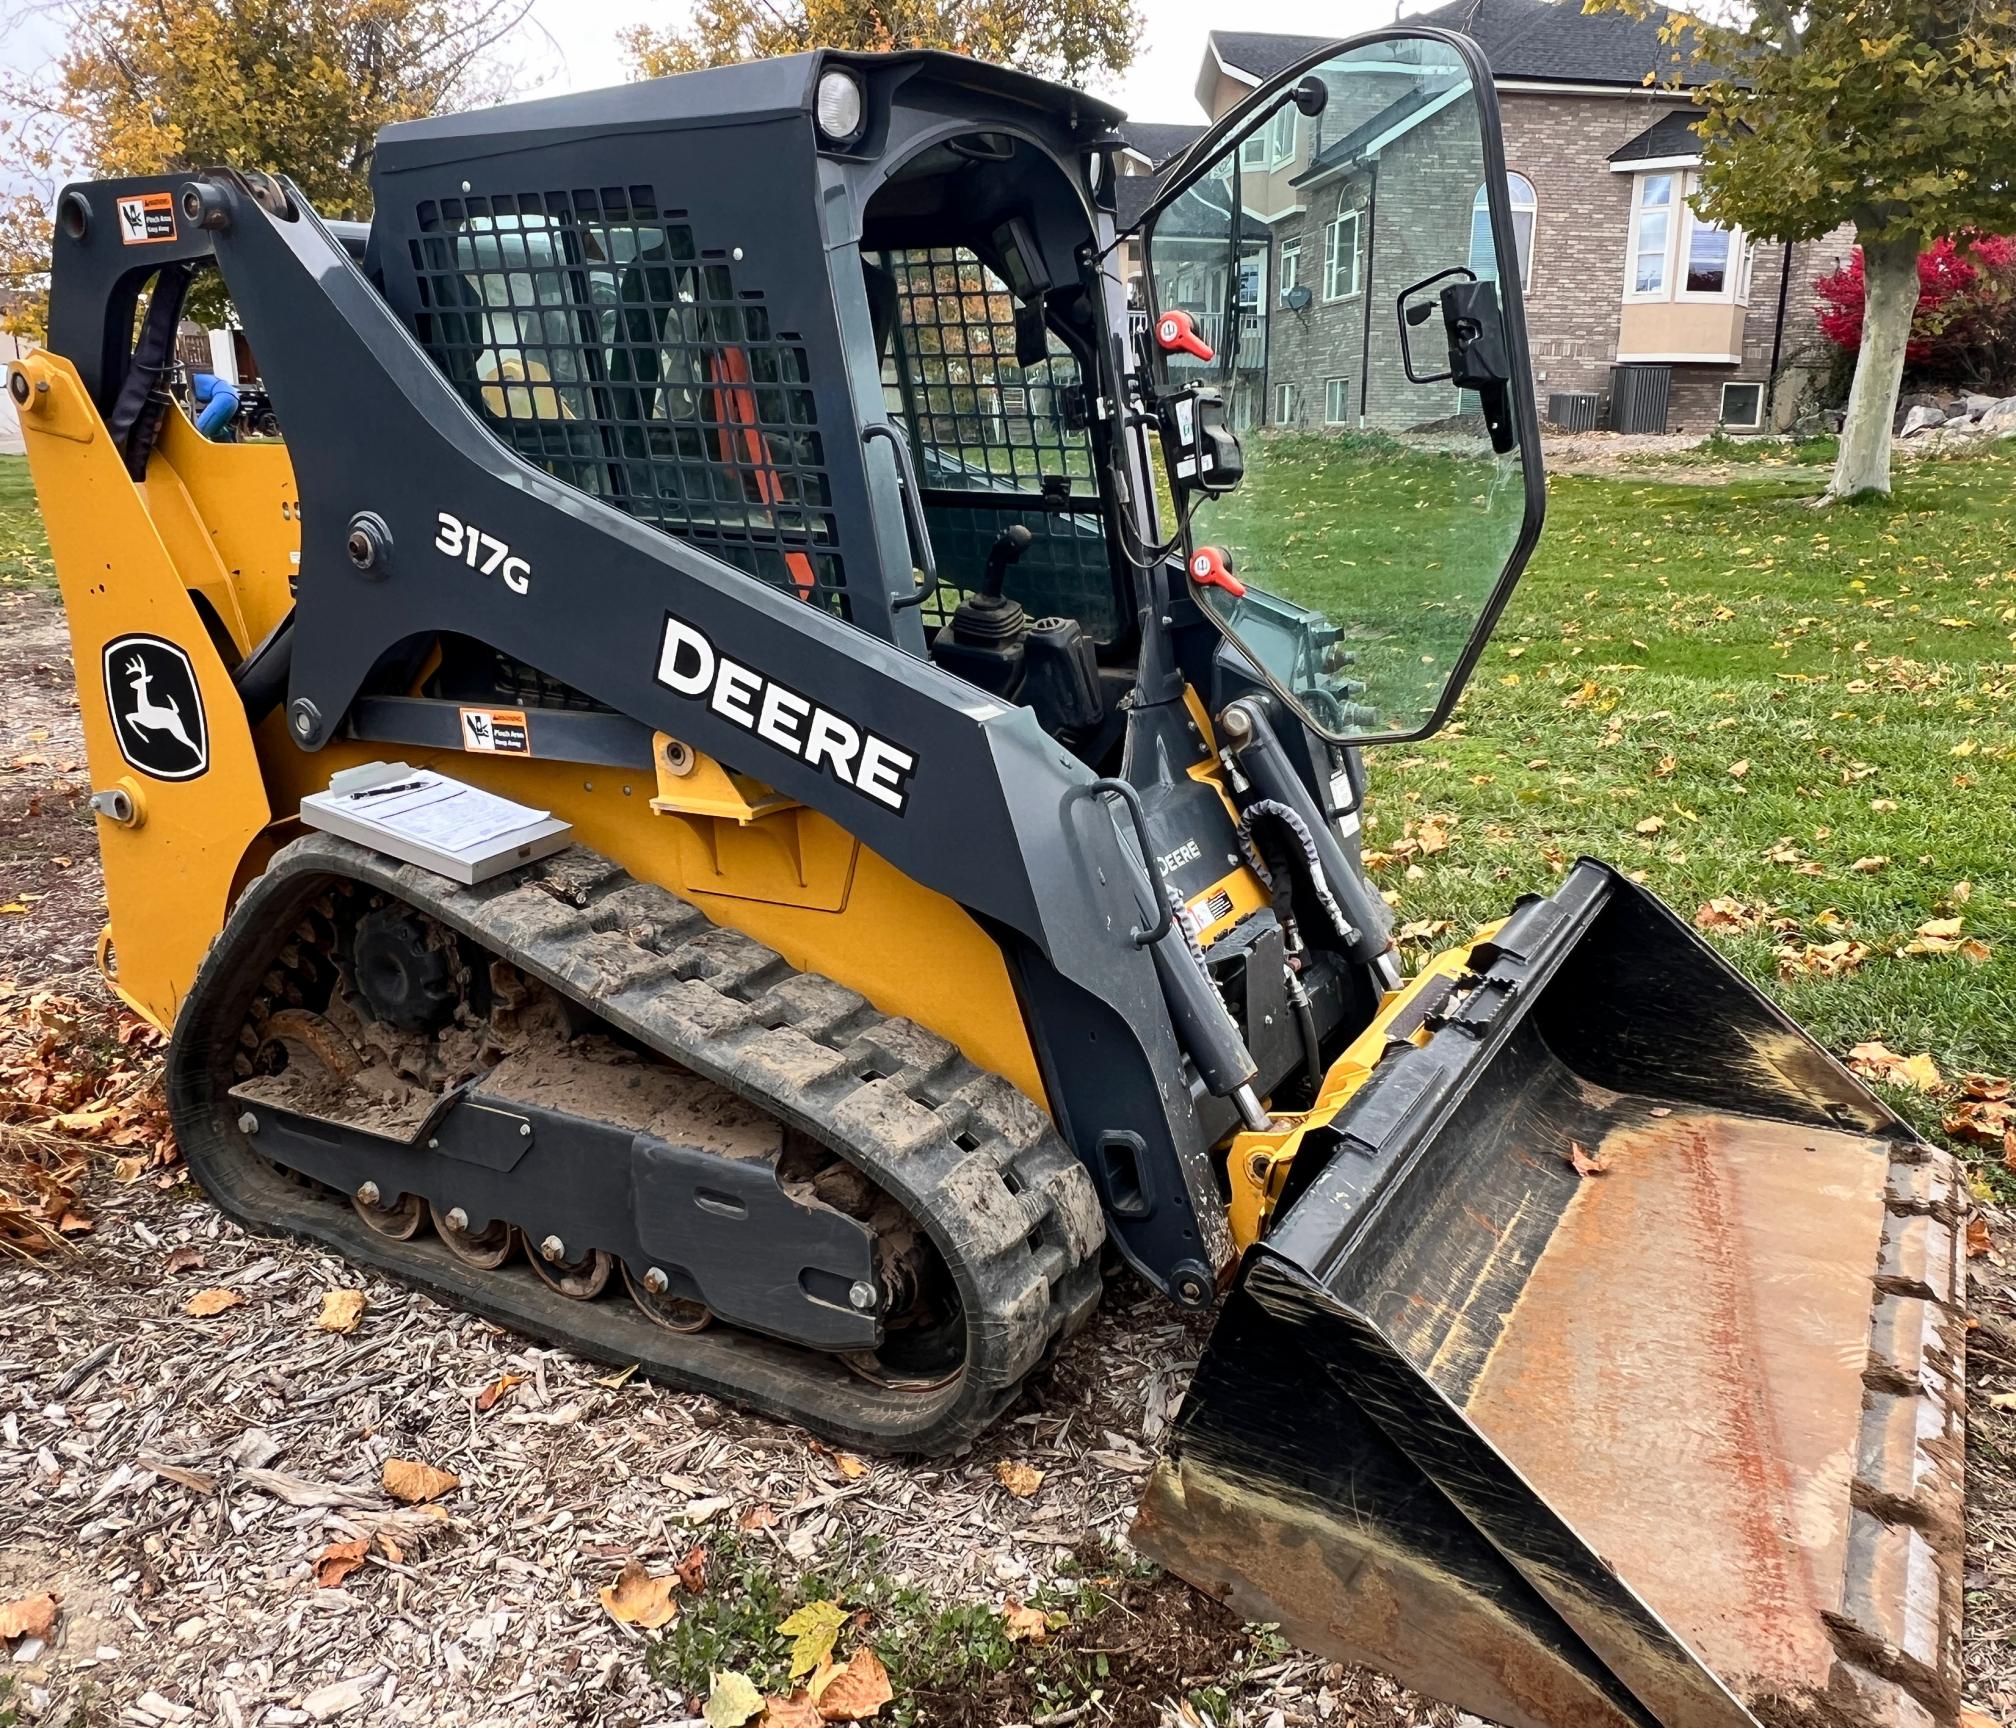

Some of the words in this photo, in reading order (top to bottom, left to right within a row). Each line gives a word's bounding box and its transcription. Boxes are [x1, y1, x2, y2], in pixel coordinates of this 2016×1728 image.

[435, 512, 531, 595] 317G
[657, 617, 913, 809] DEERE
[1156, 839, 1202, 879] DEERE
